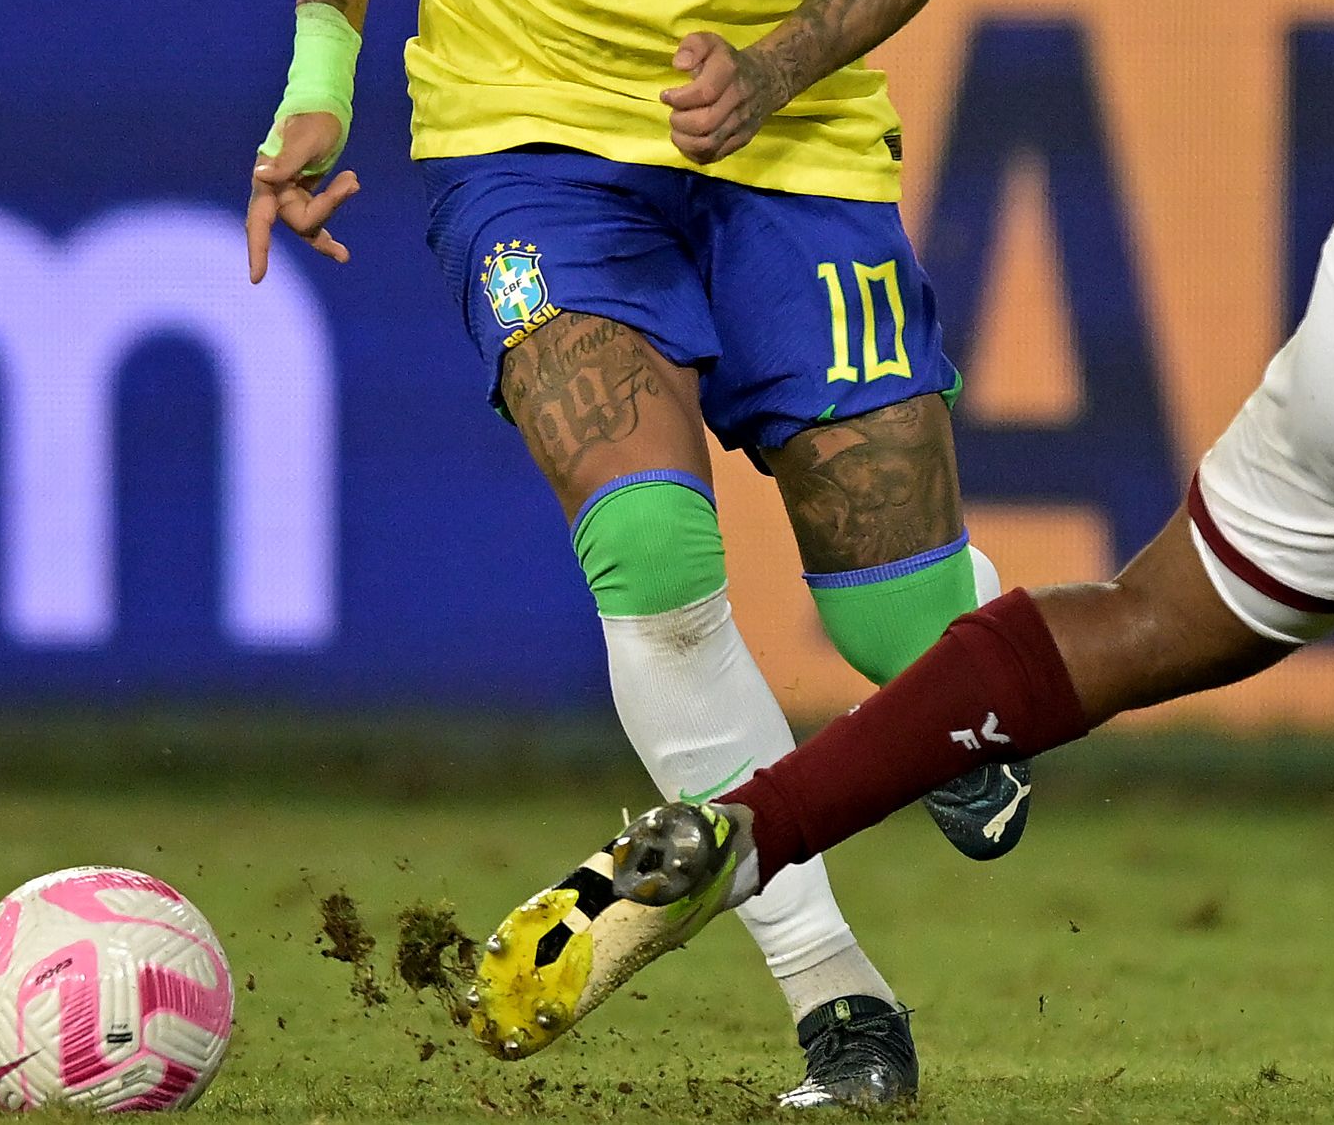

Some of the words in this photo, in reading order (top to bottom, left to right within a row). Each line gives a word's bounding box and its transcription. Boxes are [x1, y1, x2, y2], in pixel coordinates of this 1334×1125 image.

[501, 277, 525, 299] CBF
[502, 302, 563, 349] BRASIL
[817, 259, 913, 384] 10
